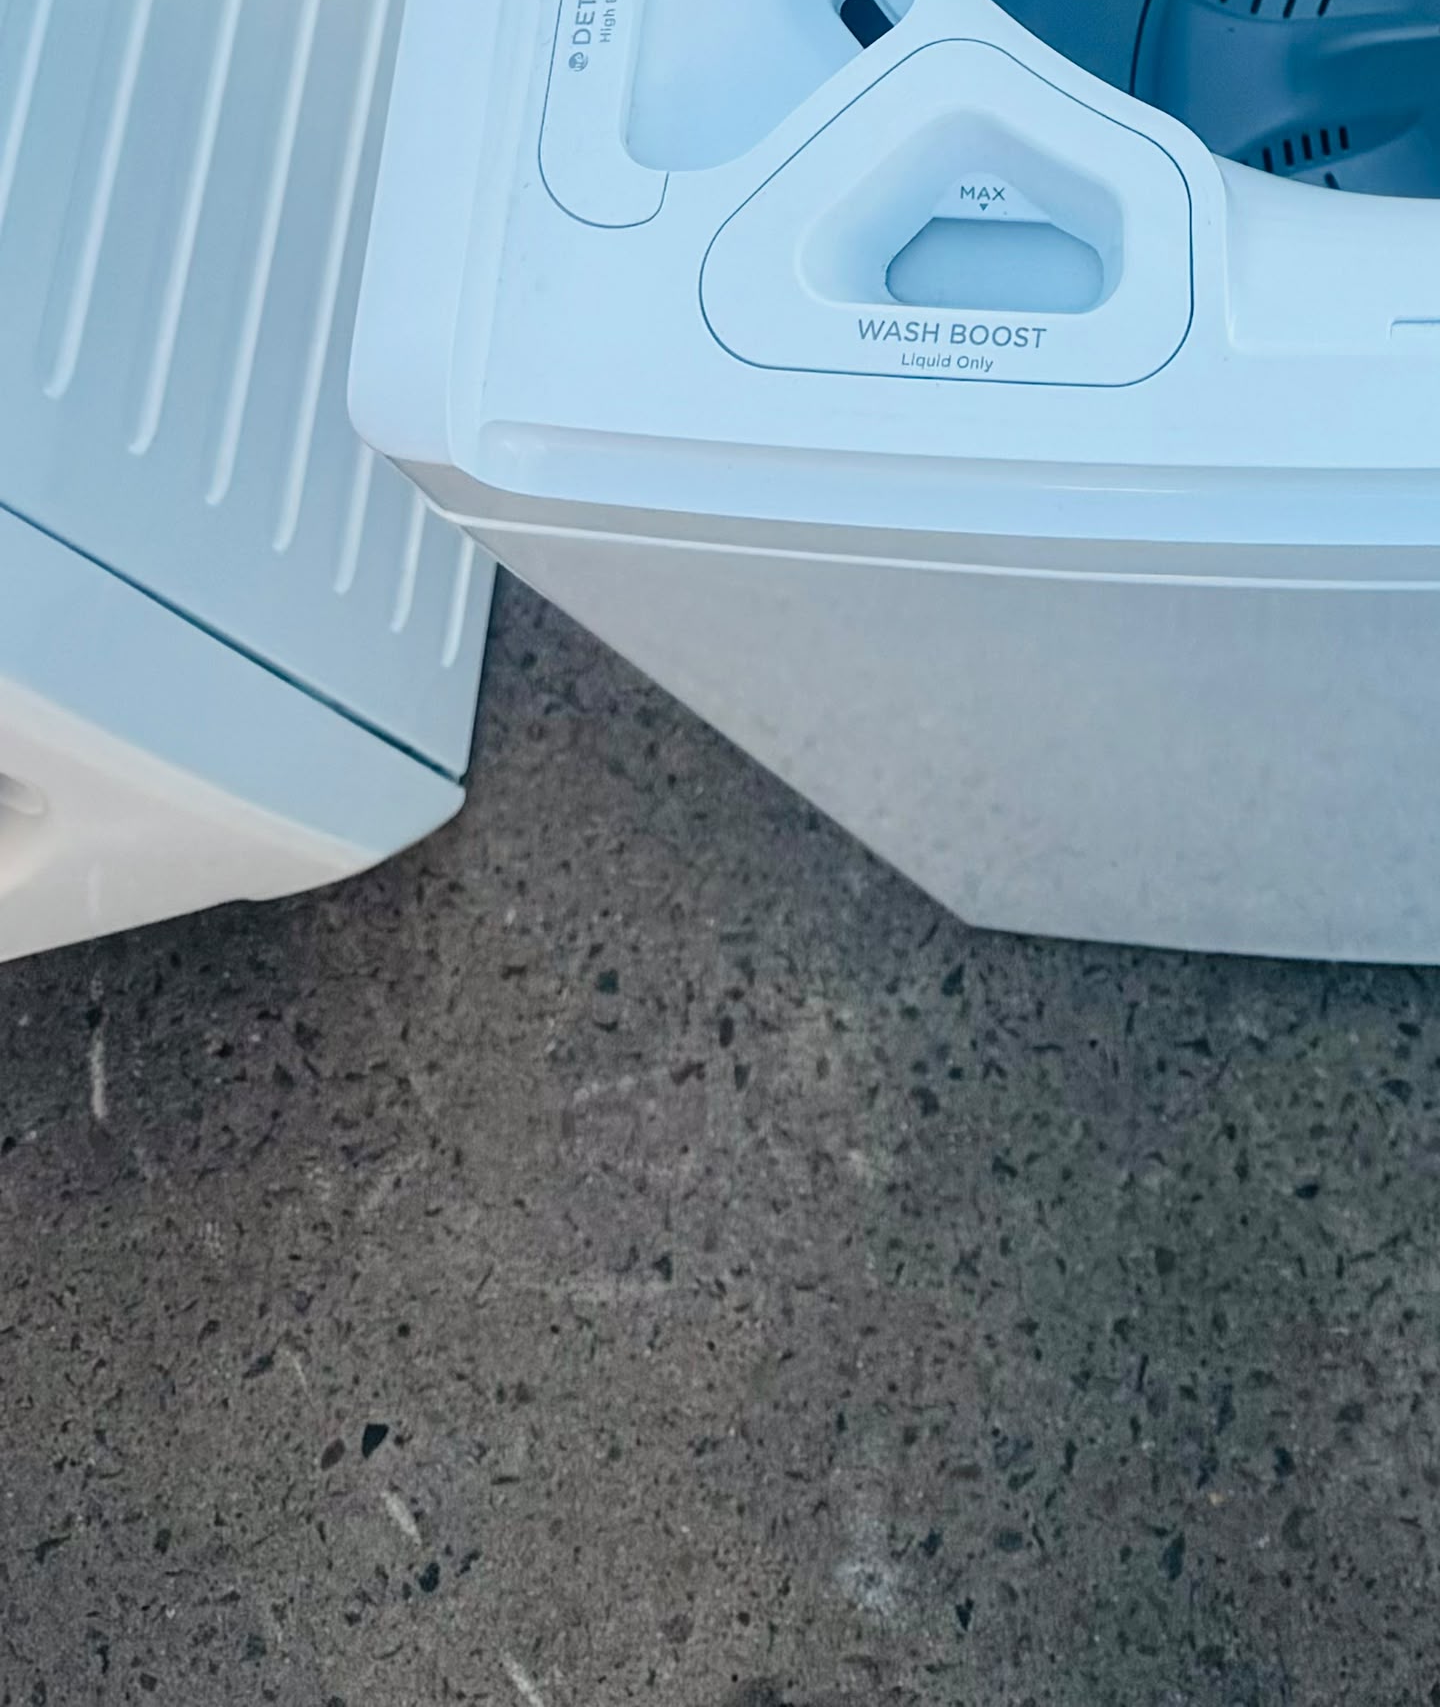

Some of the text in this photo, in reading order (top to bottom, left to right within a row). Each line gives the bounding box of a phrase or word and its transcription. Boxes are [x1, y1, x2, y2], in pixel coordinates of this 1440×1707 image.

[598, 8, 617, 43] High
[960, 186, 1006, 201] MAX
[858, 319, 1047, 349] WASH BOOST
[901, 353, 994, 373] Liquid Only
